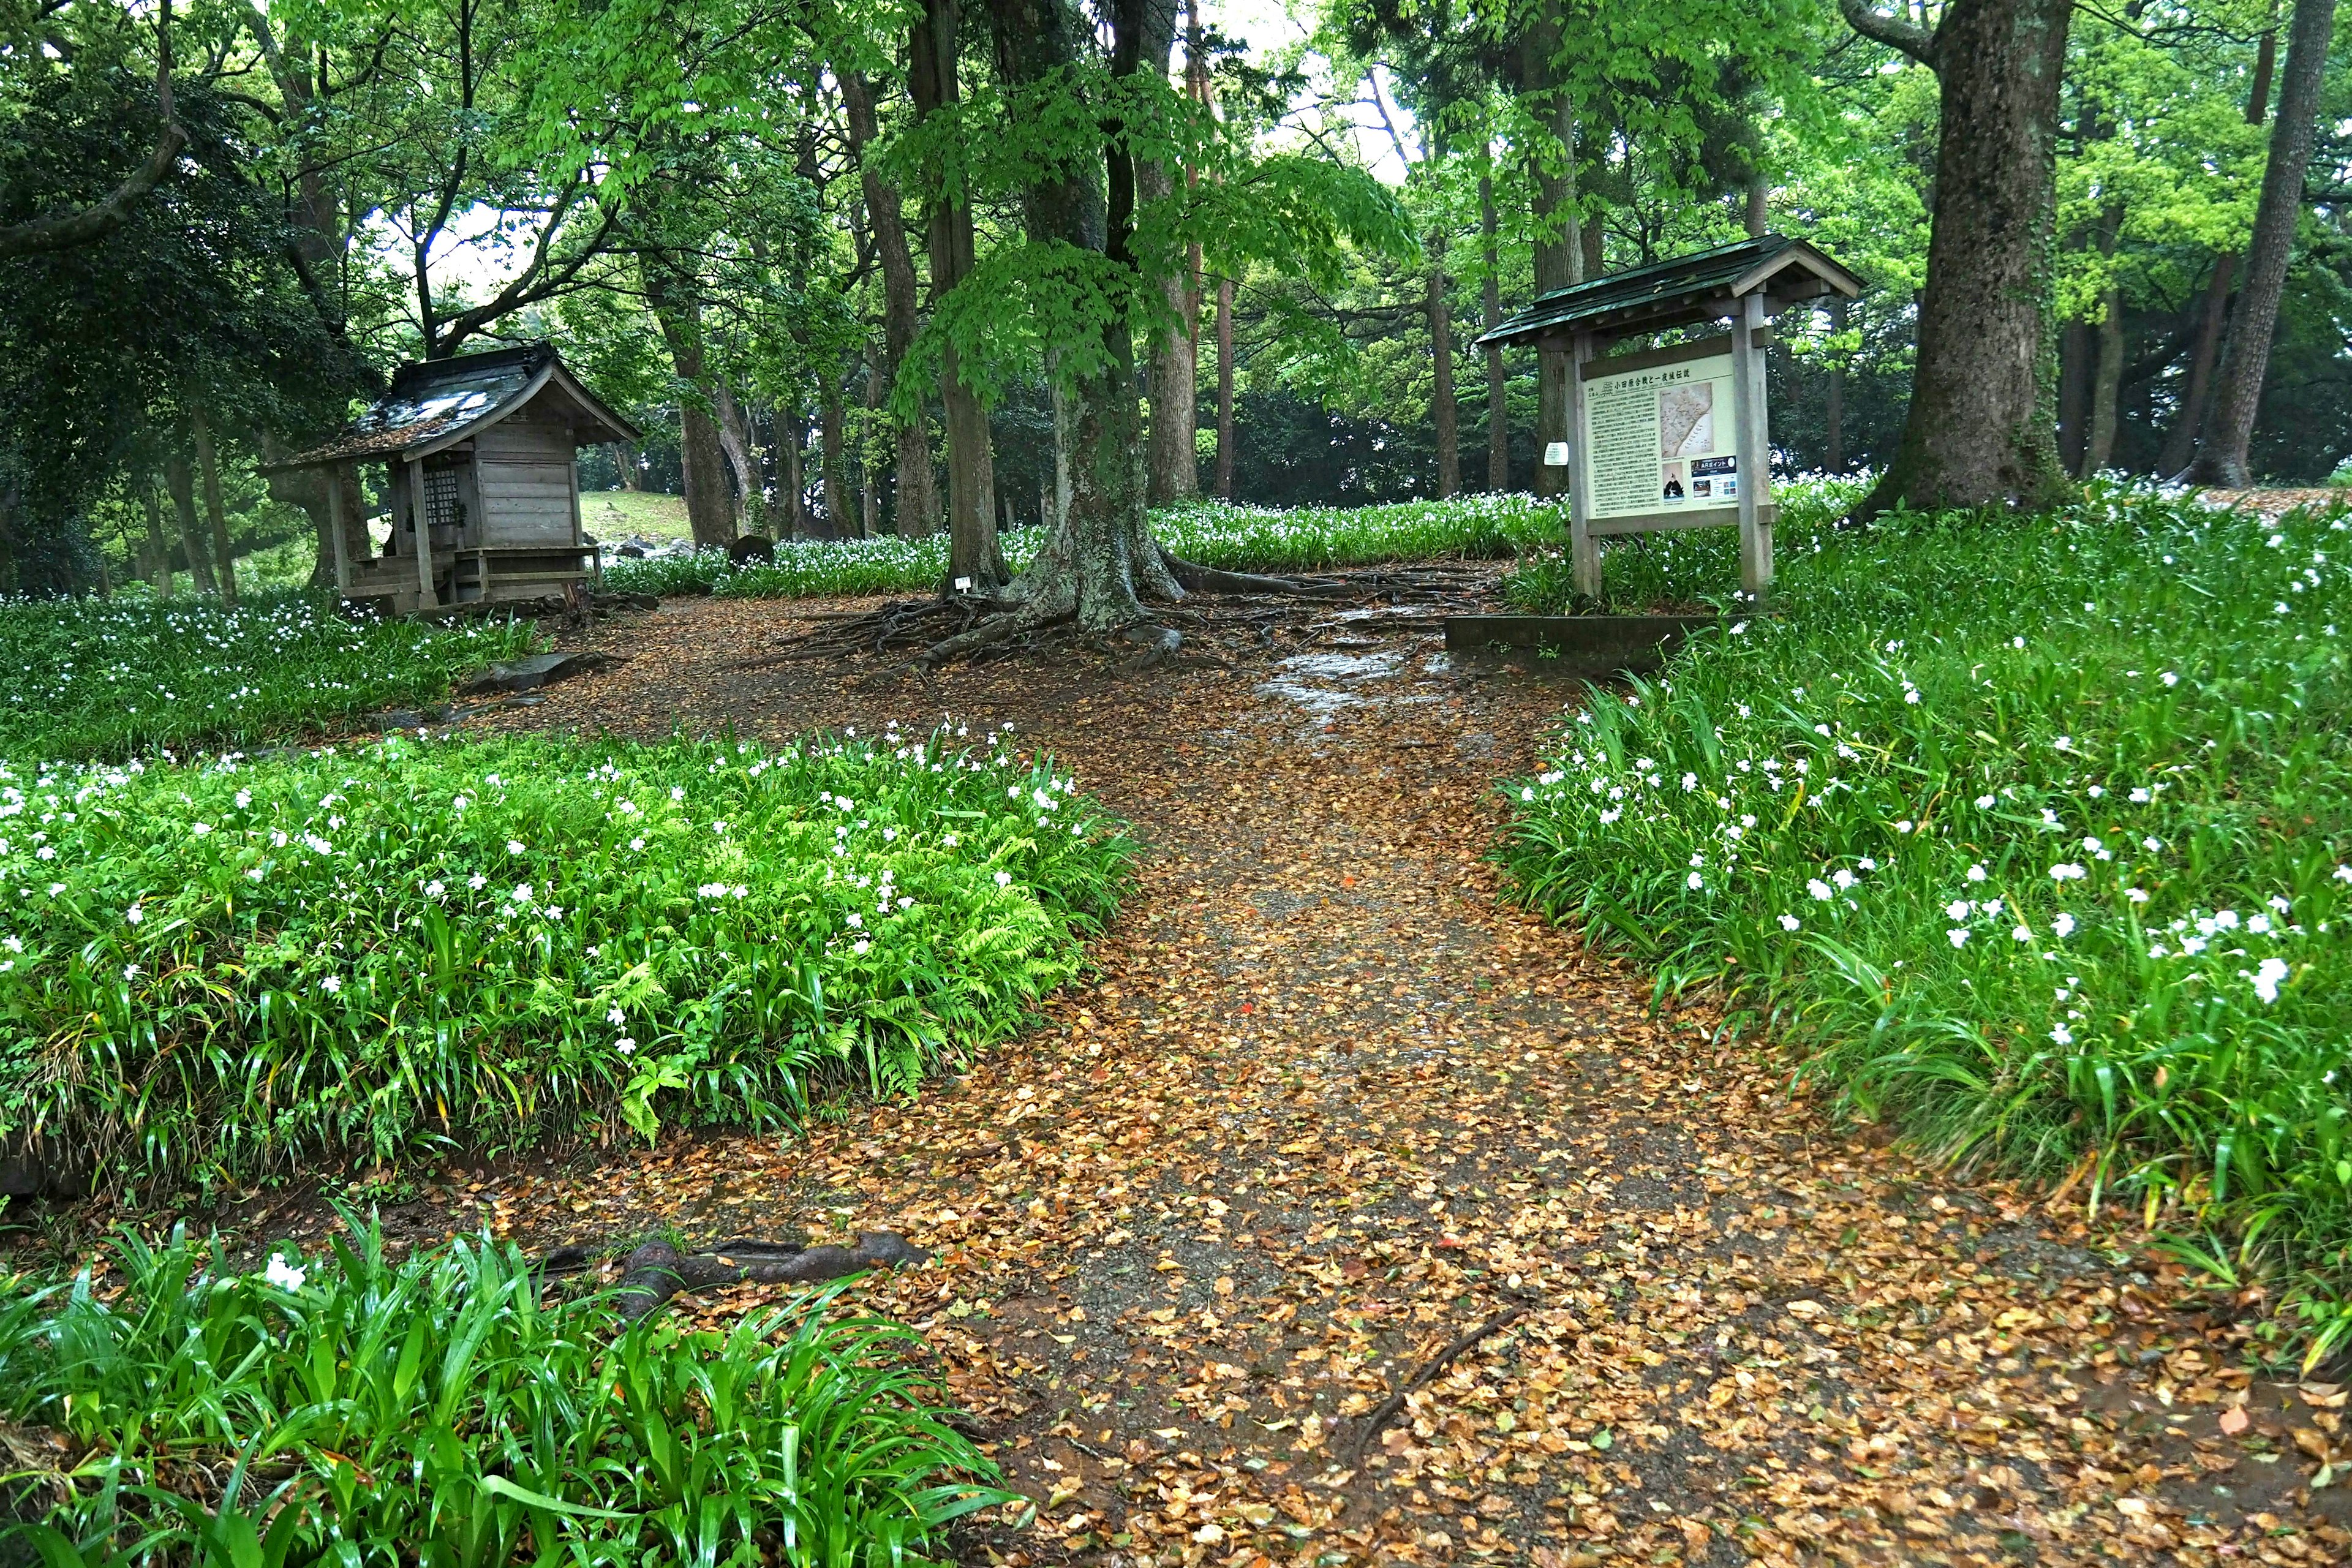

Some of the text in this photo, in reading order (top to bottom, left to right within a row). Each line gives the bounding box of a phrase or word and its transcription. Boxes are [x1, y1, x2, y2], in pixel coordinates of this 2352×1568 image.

[1615, 369, 1690, 390] 小田原合戦と一夜城伝説
